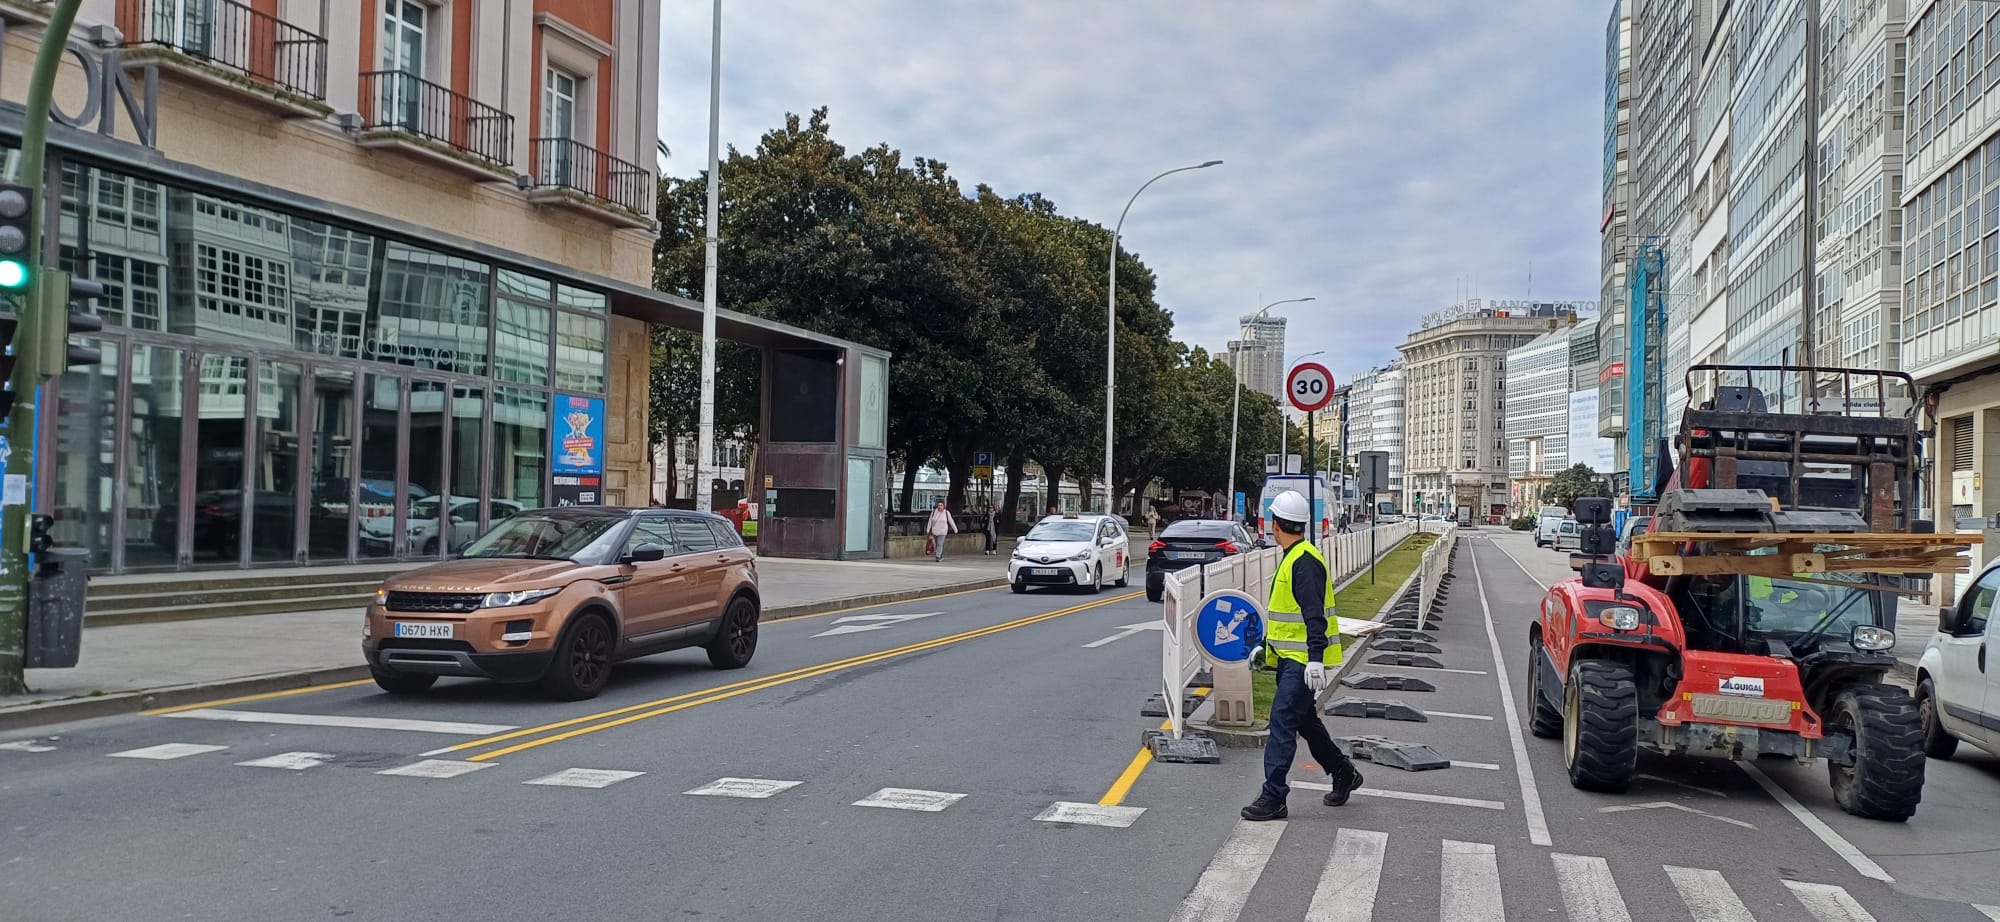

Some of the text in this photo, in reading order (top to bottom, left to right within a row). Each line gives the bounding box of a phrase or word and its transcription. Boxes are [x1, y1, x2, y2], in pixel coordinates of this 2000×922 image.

[1490, 300, 1542, 311] BANCO
[1296, 379, 1323, 395] 30
[979, 454, 987, 464] P
[401, 625, 450, 636] 0670 HXR
[1721, 681, 1763, 692] ALQUIGAL
[1694, 699, 1789, 720] MANITOU
